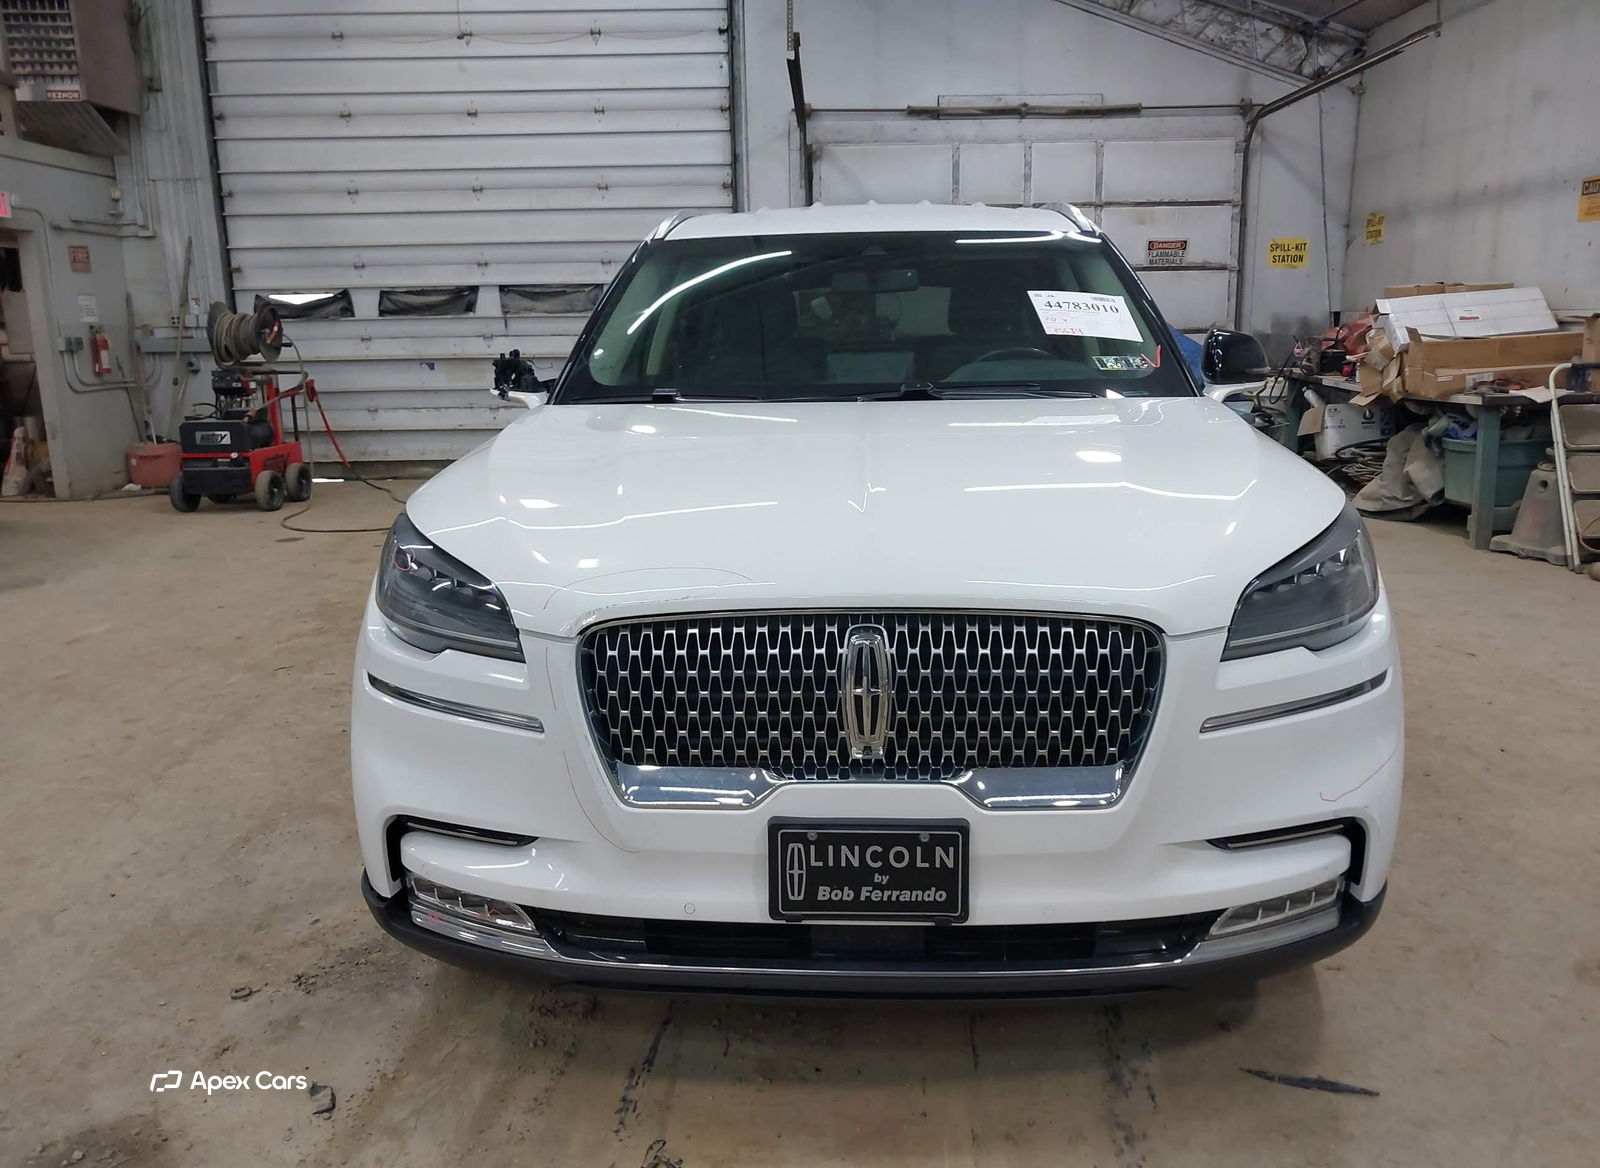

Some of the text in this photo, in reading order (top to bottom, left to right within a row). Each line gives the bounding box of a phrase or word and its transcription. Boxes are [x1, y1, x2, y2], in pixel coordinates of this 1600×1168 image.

[1270, 242, 1307, 252] SPILL-KIT
[1272, 254, 1304, 263] STATION
[1044, 300, 1119, 314] 44783010
[810, 845, 954, 868] LINCOLN
[874, 873, 889, 884] by
[817, 886, 947, 902] Bob Ferrando
